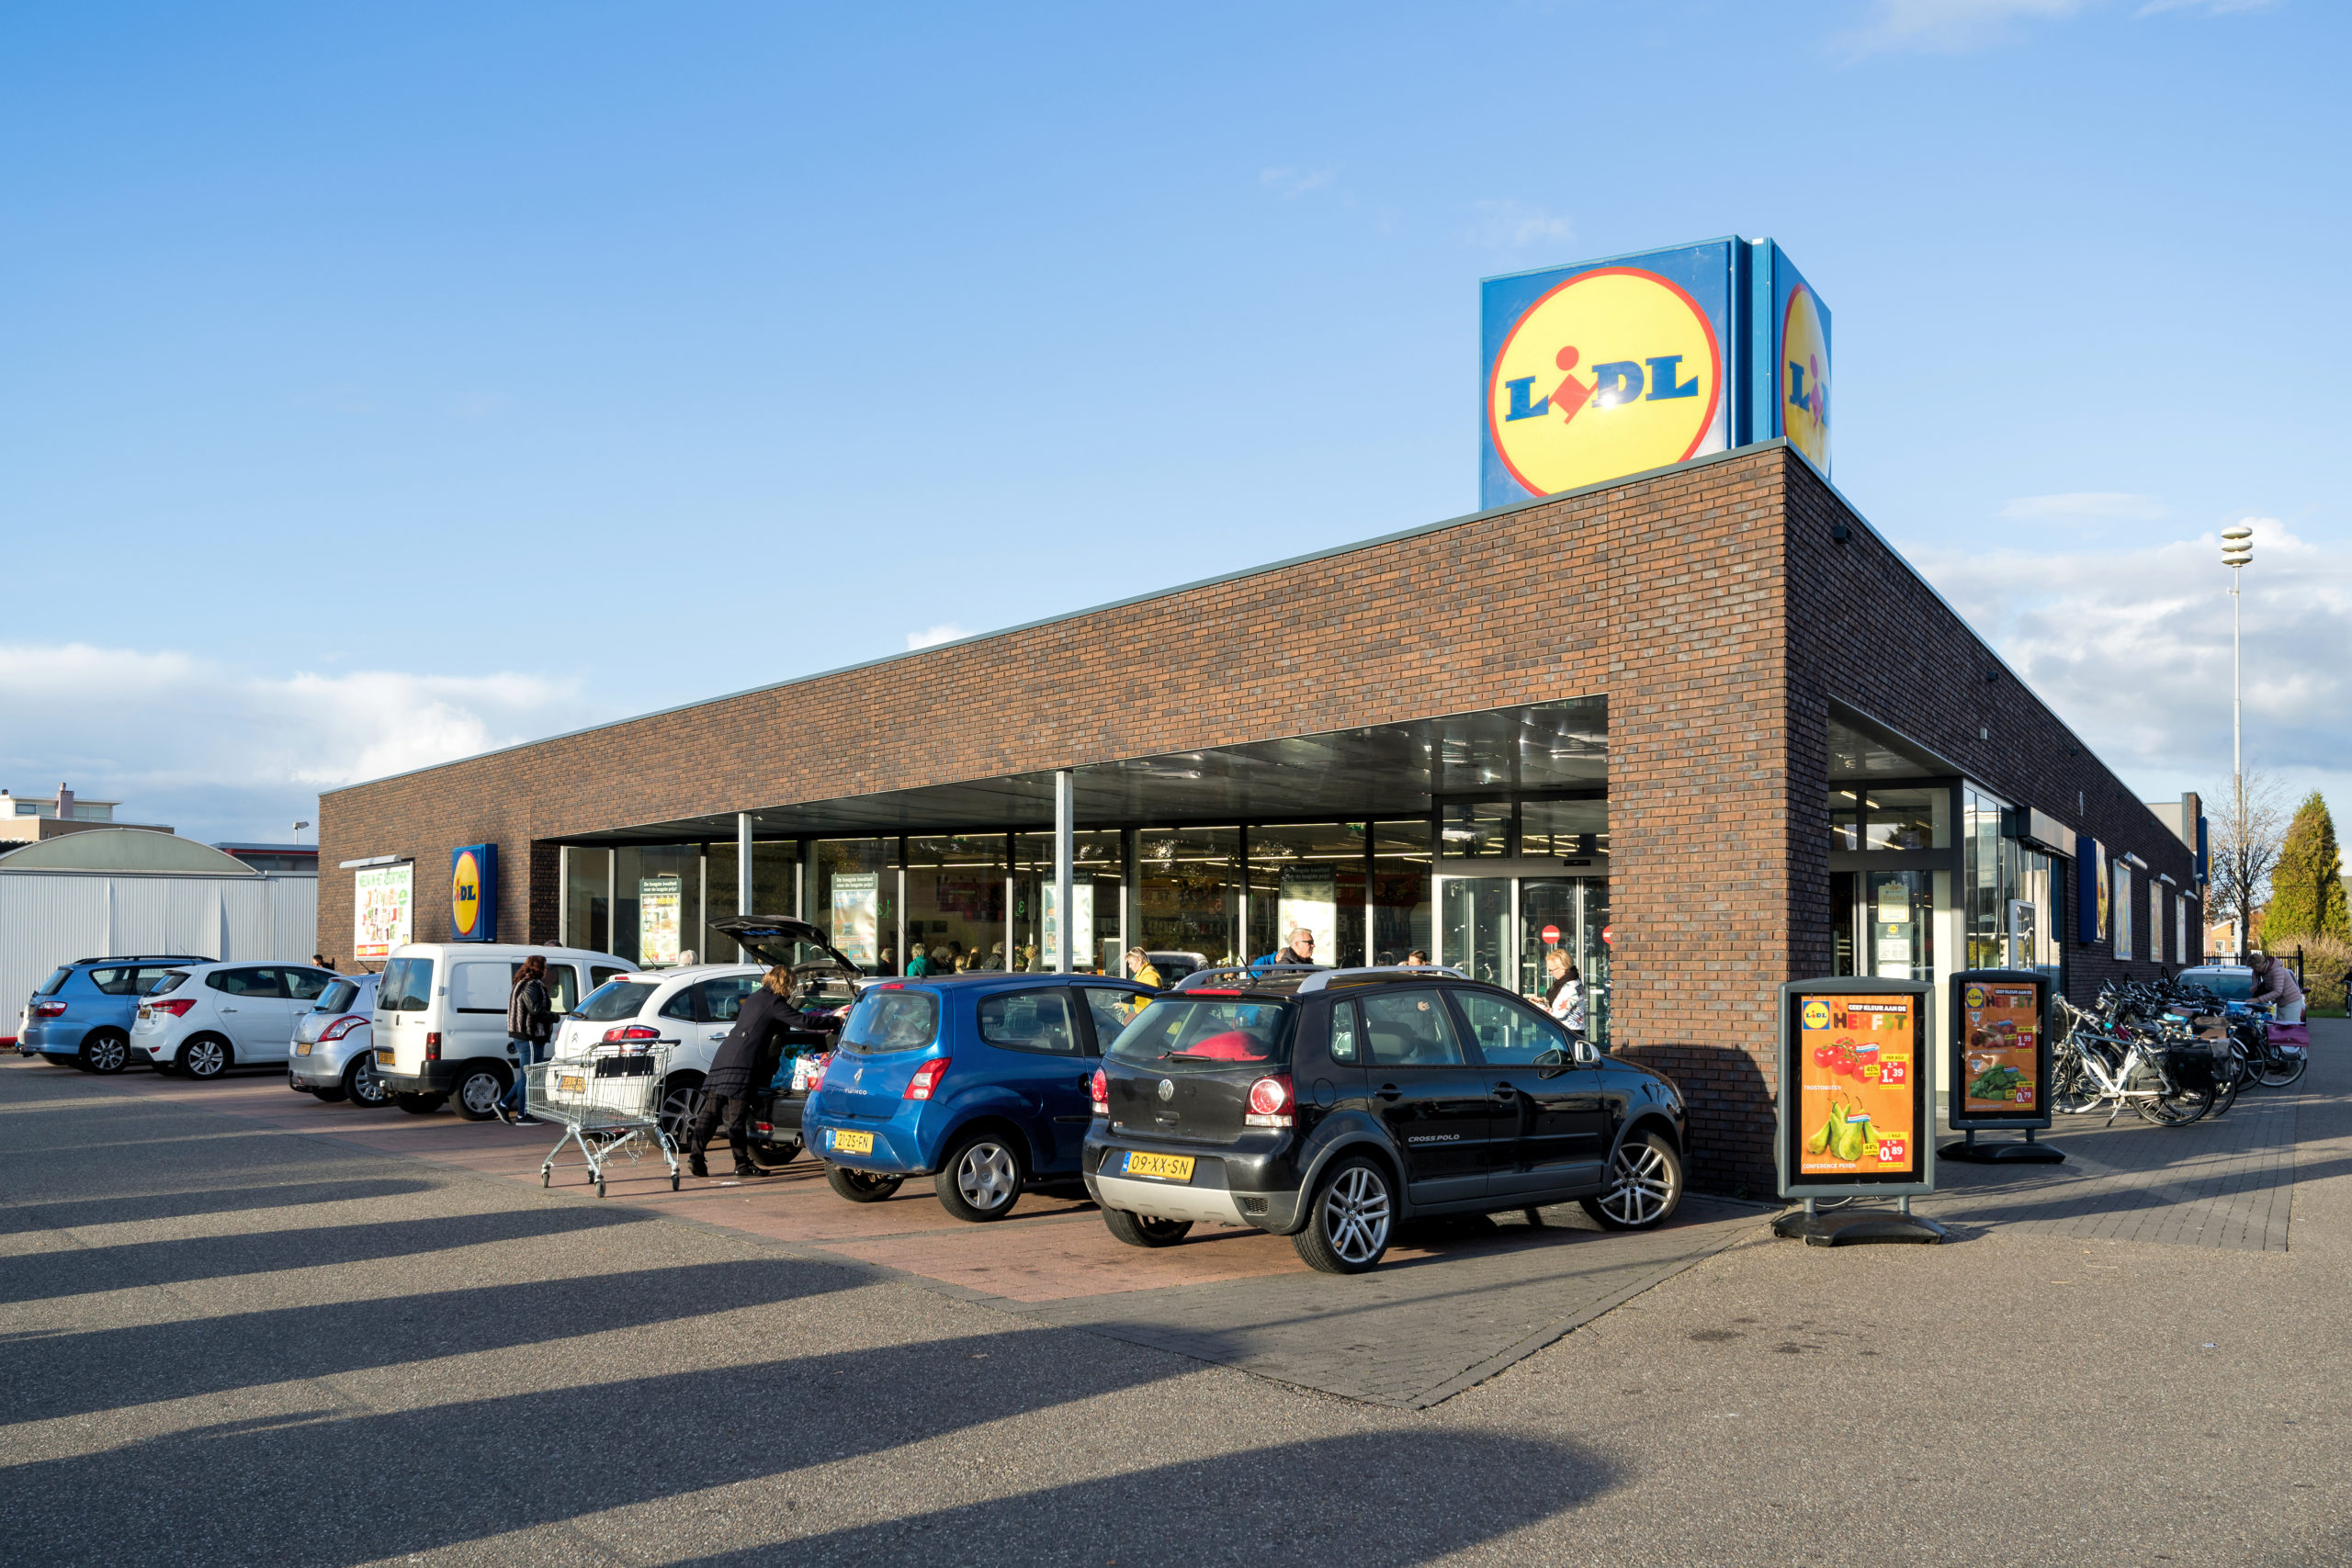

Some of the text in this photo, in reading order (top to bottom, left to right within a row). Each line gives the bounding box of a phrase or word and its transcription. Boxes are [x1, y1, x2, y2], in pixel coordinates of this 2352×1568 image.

[1882, 1068, 1904, 1083] 1.39
[844, 1088, 867, 1096] TWINGO
[1880, 1146, 1903, 1161] 0.89
[1131, 1155, 1189, 1176] 09-XX-SN
